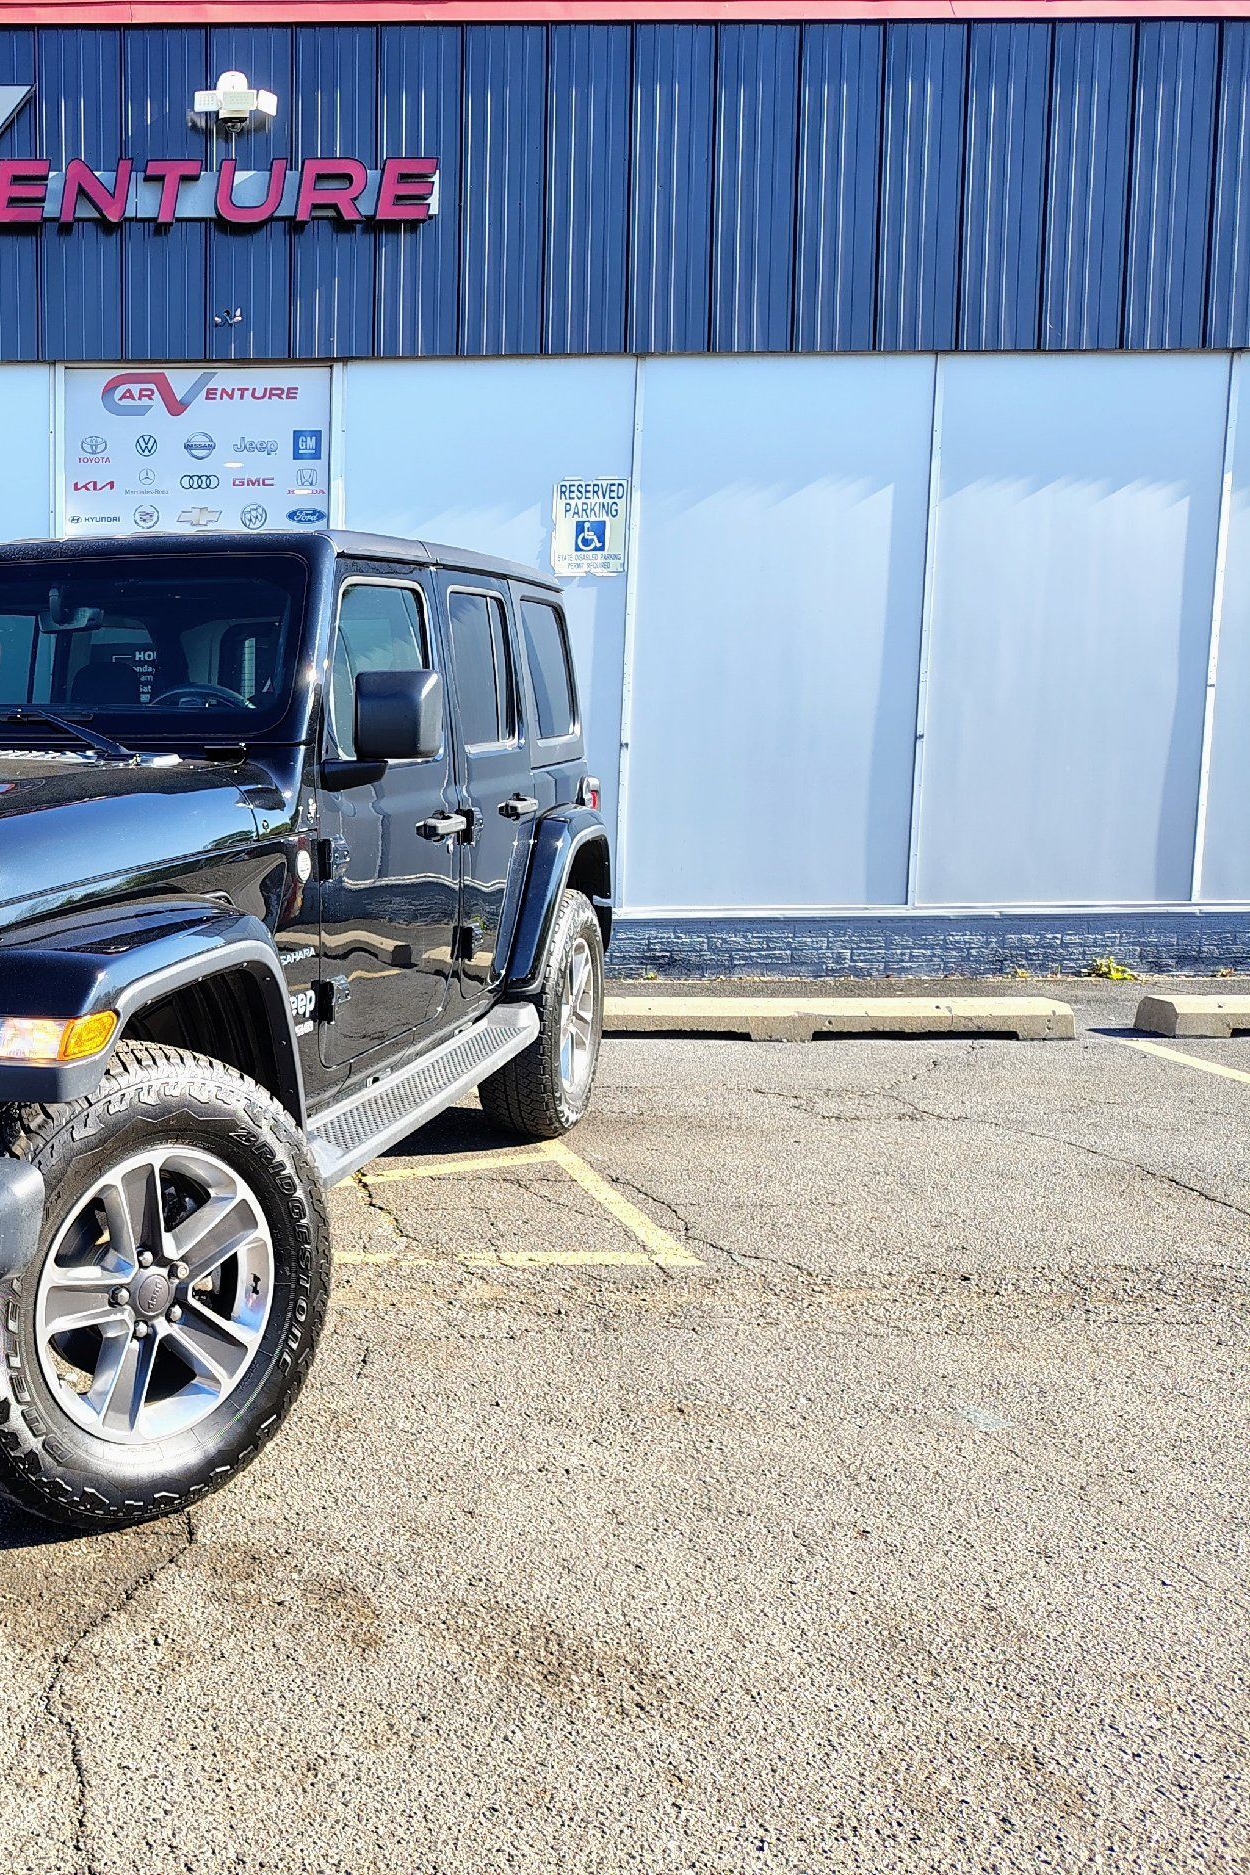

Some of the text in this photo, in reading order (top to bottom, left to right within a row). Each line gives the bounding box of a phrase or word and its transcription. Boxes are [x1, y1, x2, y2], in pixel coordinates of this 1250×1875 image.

[233, 437, 278, 455] Jeep
[298, 436, 316, 450] GM
[73, 480, 115, 491] KIA
[232, 477, 275, 487] GMC
[559, 483, 625, 500] RESERVED
[293, 511, 319, 521] Ford
[564, 501, 619, 518] PARKING
[279, 946, 317, 966] SAHARA
[289, 989, 316, 1018] eep
